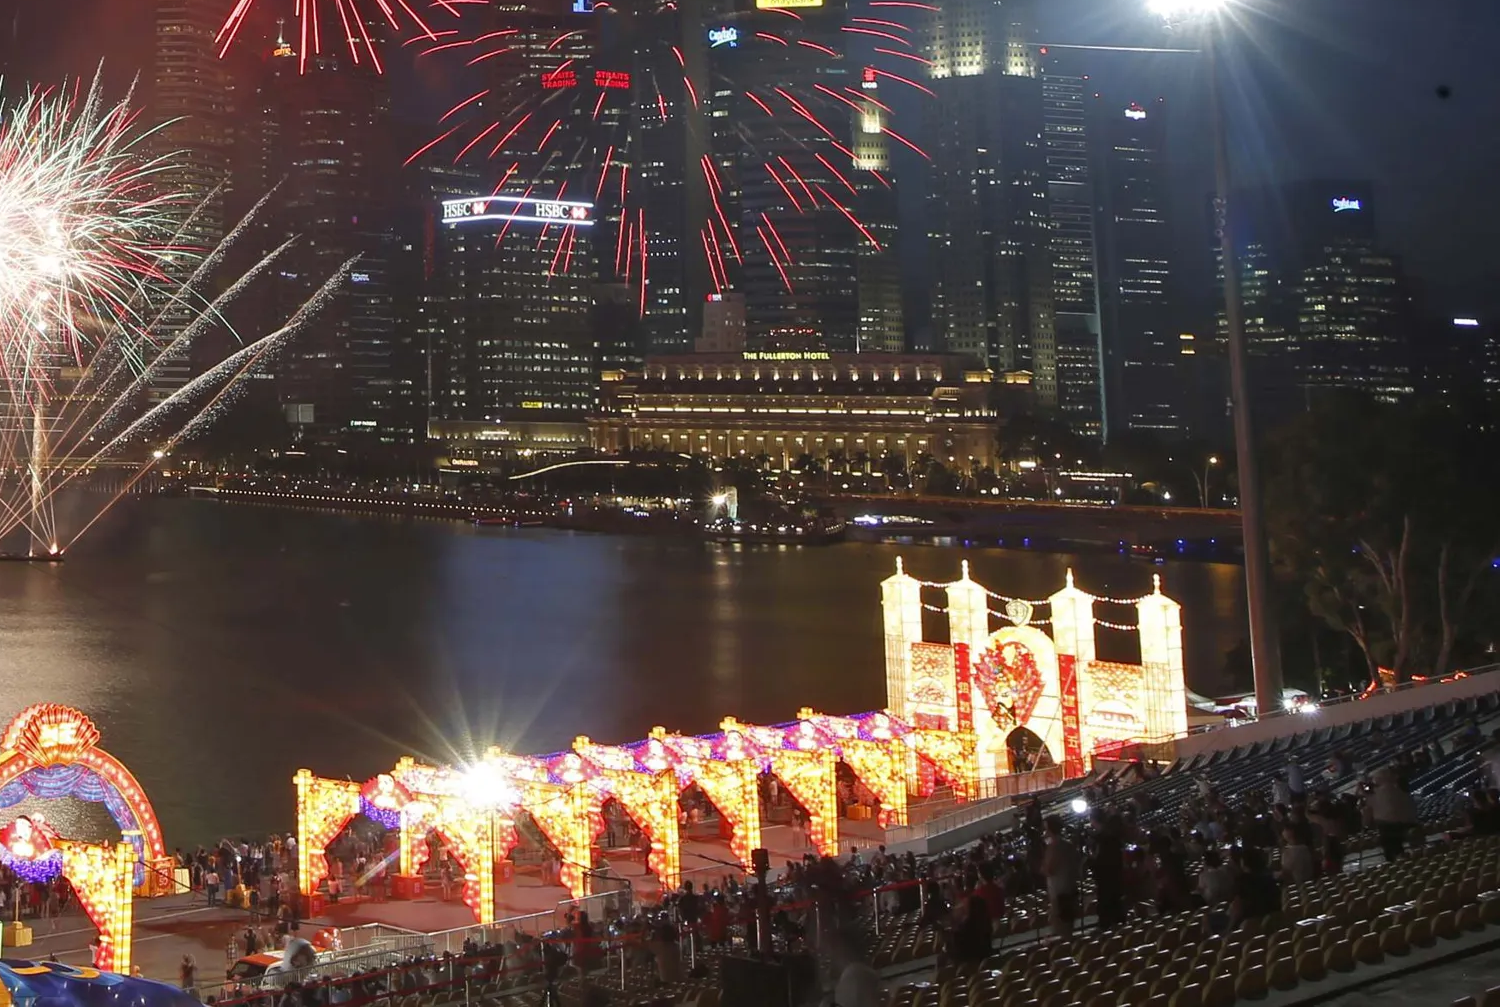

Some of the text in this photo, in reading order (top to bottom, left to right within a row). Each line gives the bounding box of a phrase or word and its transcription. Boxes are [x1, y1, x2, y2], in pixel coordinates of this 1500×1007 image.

[541, 71, 575, 81] STRAITS
[595, 70, 630, 81] STRAITS
[542, 79, 577, 89] TRADING
[594, 79, 630, 89] TRADING
[861, 81, 878, 89] UOB
[443, 202, 471, 218] HSBC
[535, 203, 569, 219] HSBC
[759, 352, 802, 360] FULLERTON
[803, 352, 830, 360] HOTEL
